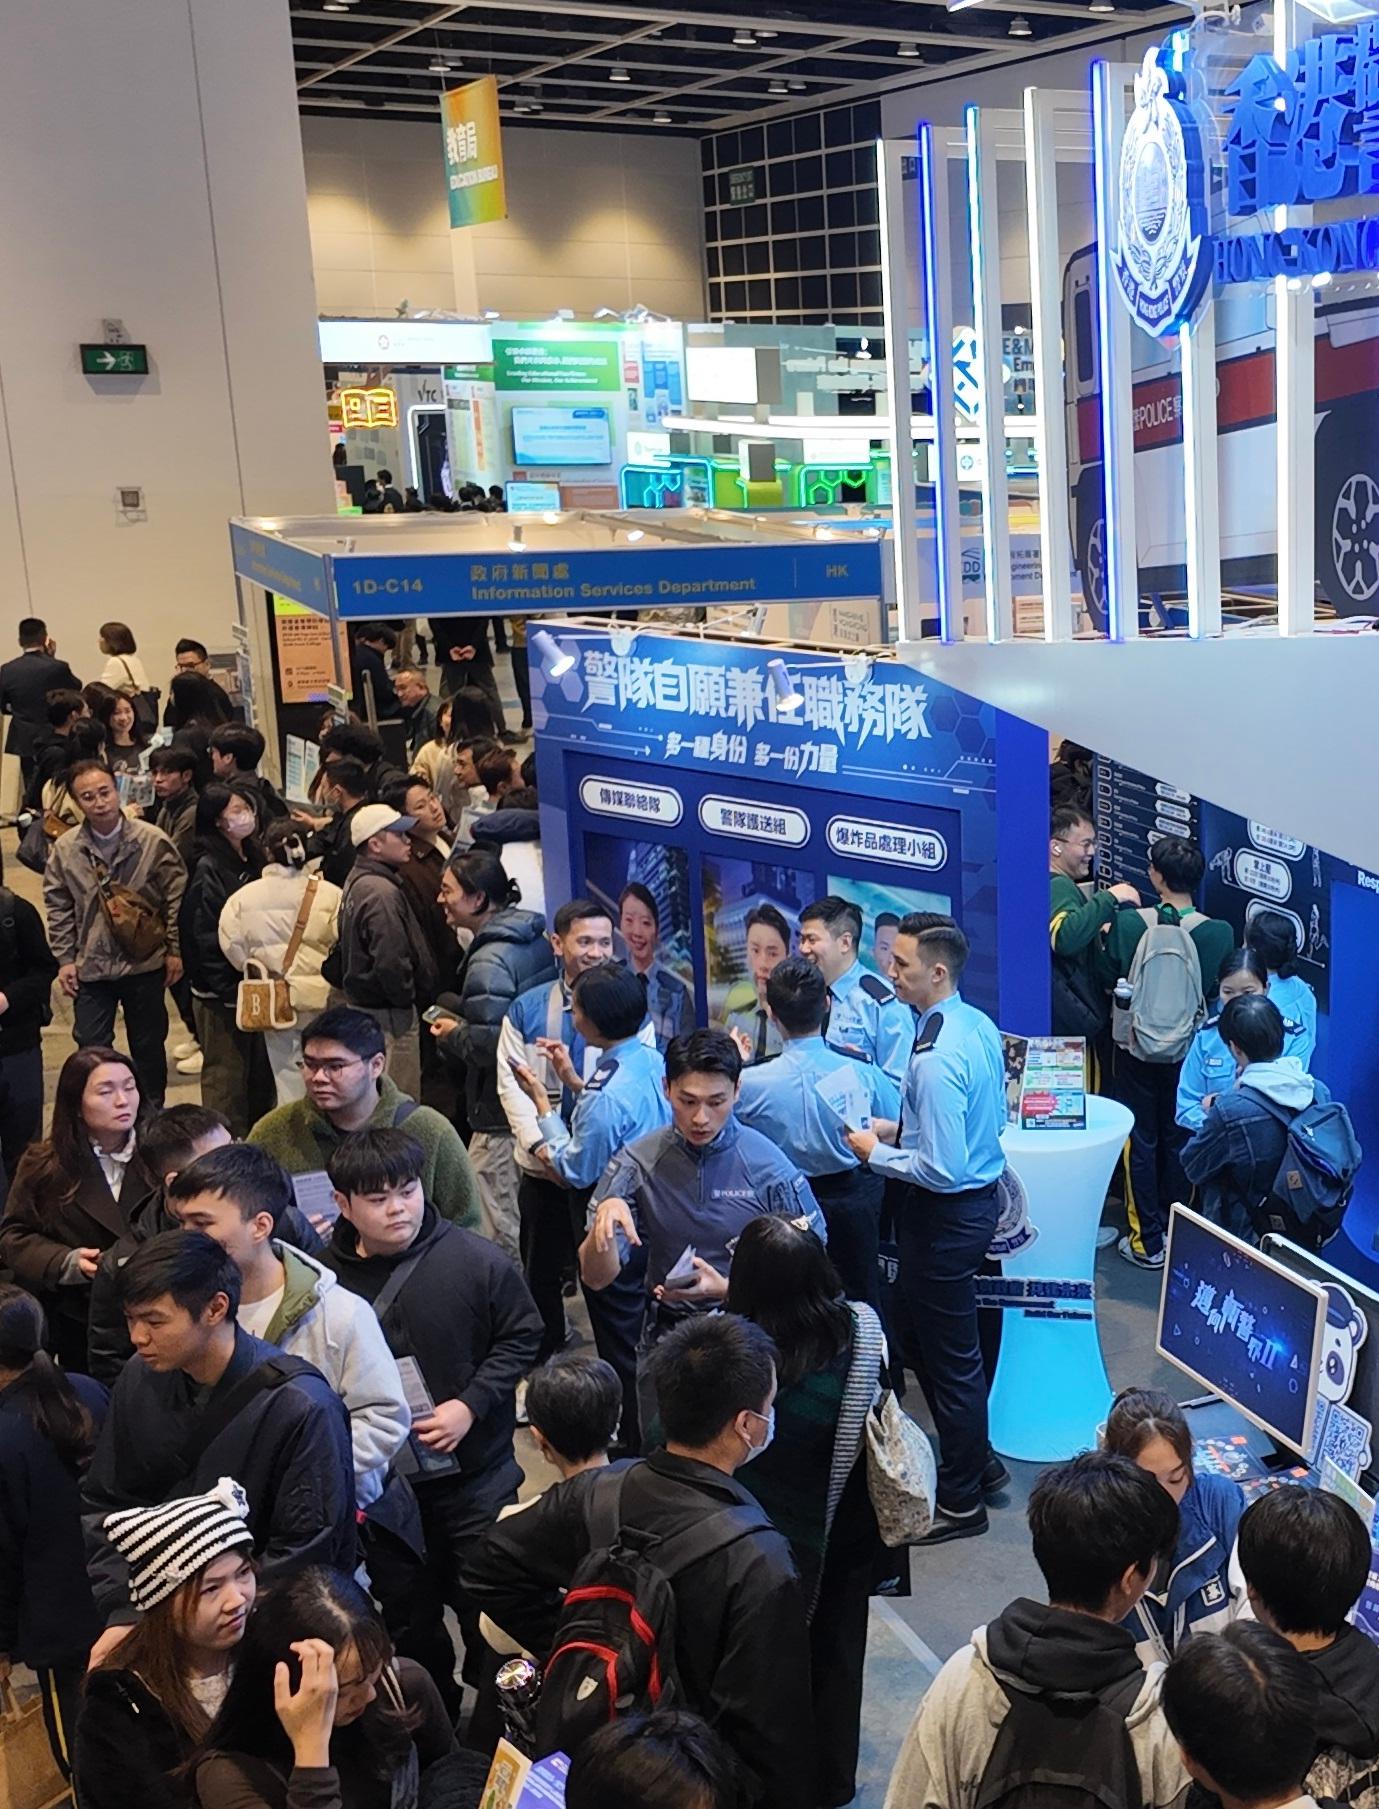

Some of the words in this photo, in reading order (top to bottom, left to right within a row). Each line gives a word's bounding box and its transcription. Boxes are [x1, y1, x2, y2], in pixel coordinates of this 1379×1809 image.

[1213, 231, 1287, 283] HONG
[1140, 397, 1173, 429] POLICE
[353, 578, 424, 595] 1D-C14
[471, 583, 575, 600] Information
[579, 581, 653, 597] Services
[658, 578, 757, 596] Department
[825, 564, 849, 578] HK
[470, 563, 570, 581] 政府新聞處
[581, 648, 934, 751] 警隊自願兼任職務隊
[835, 825, 938, 862] 爆炸品處理小組
